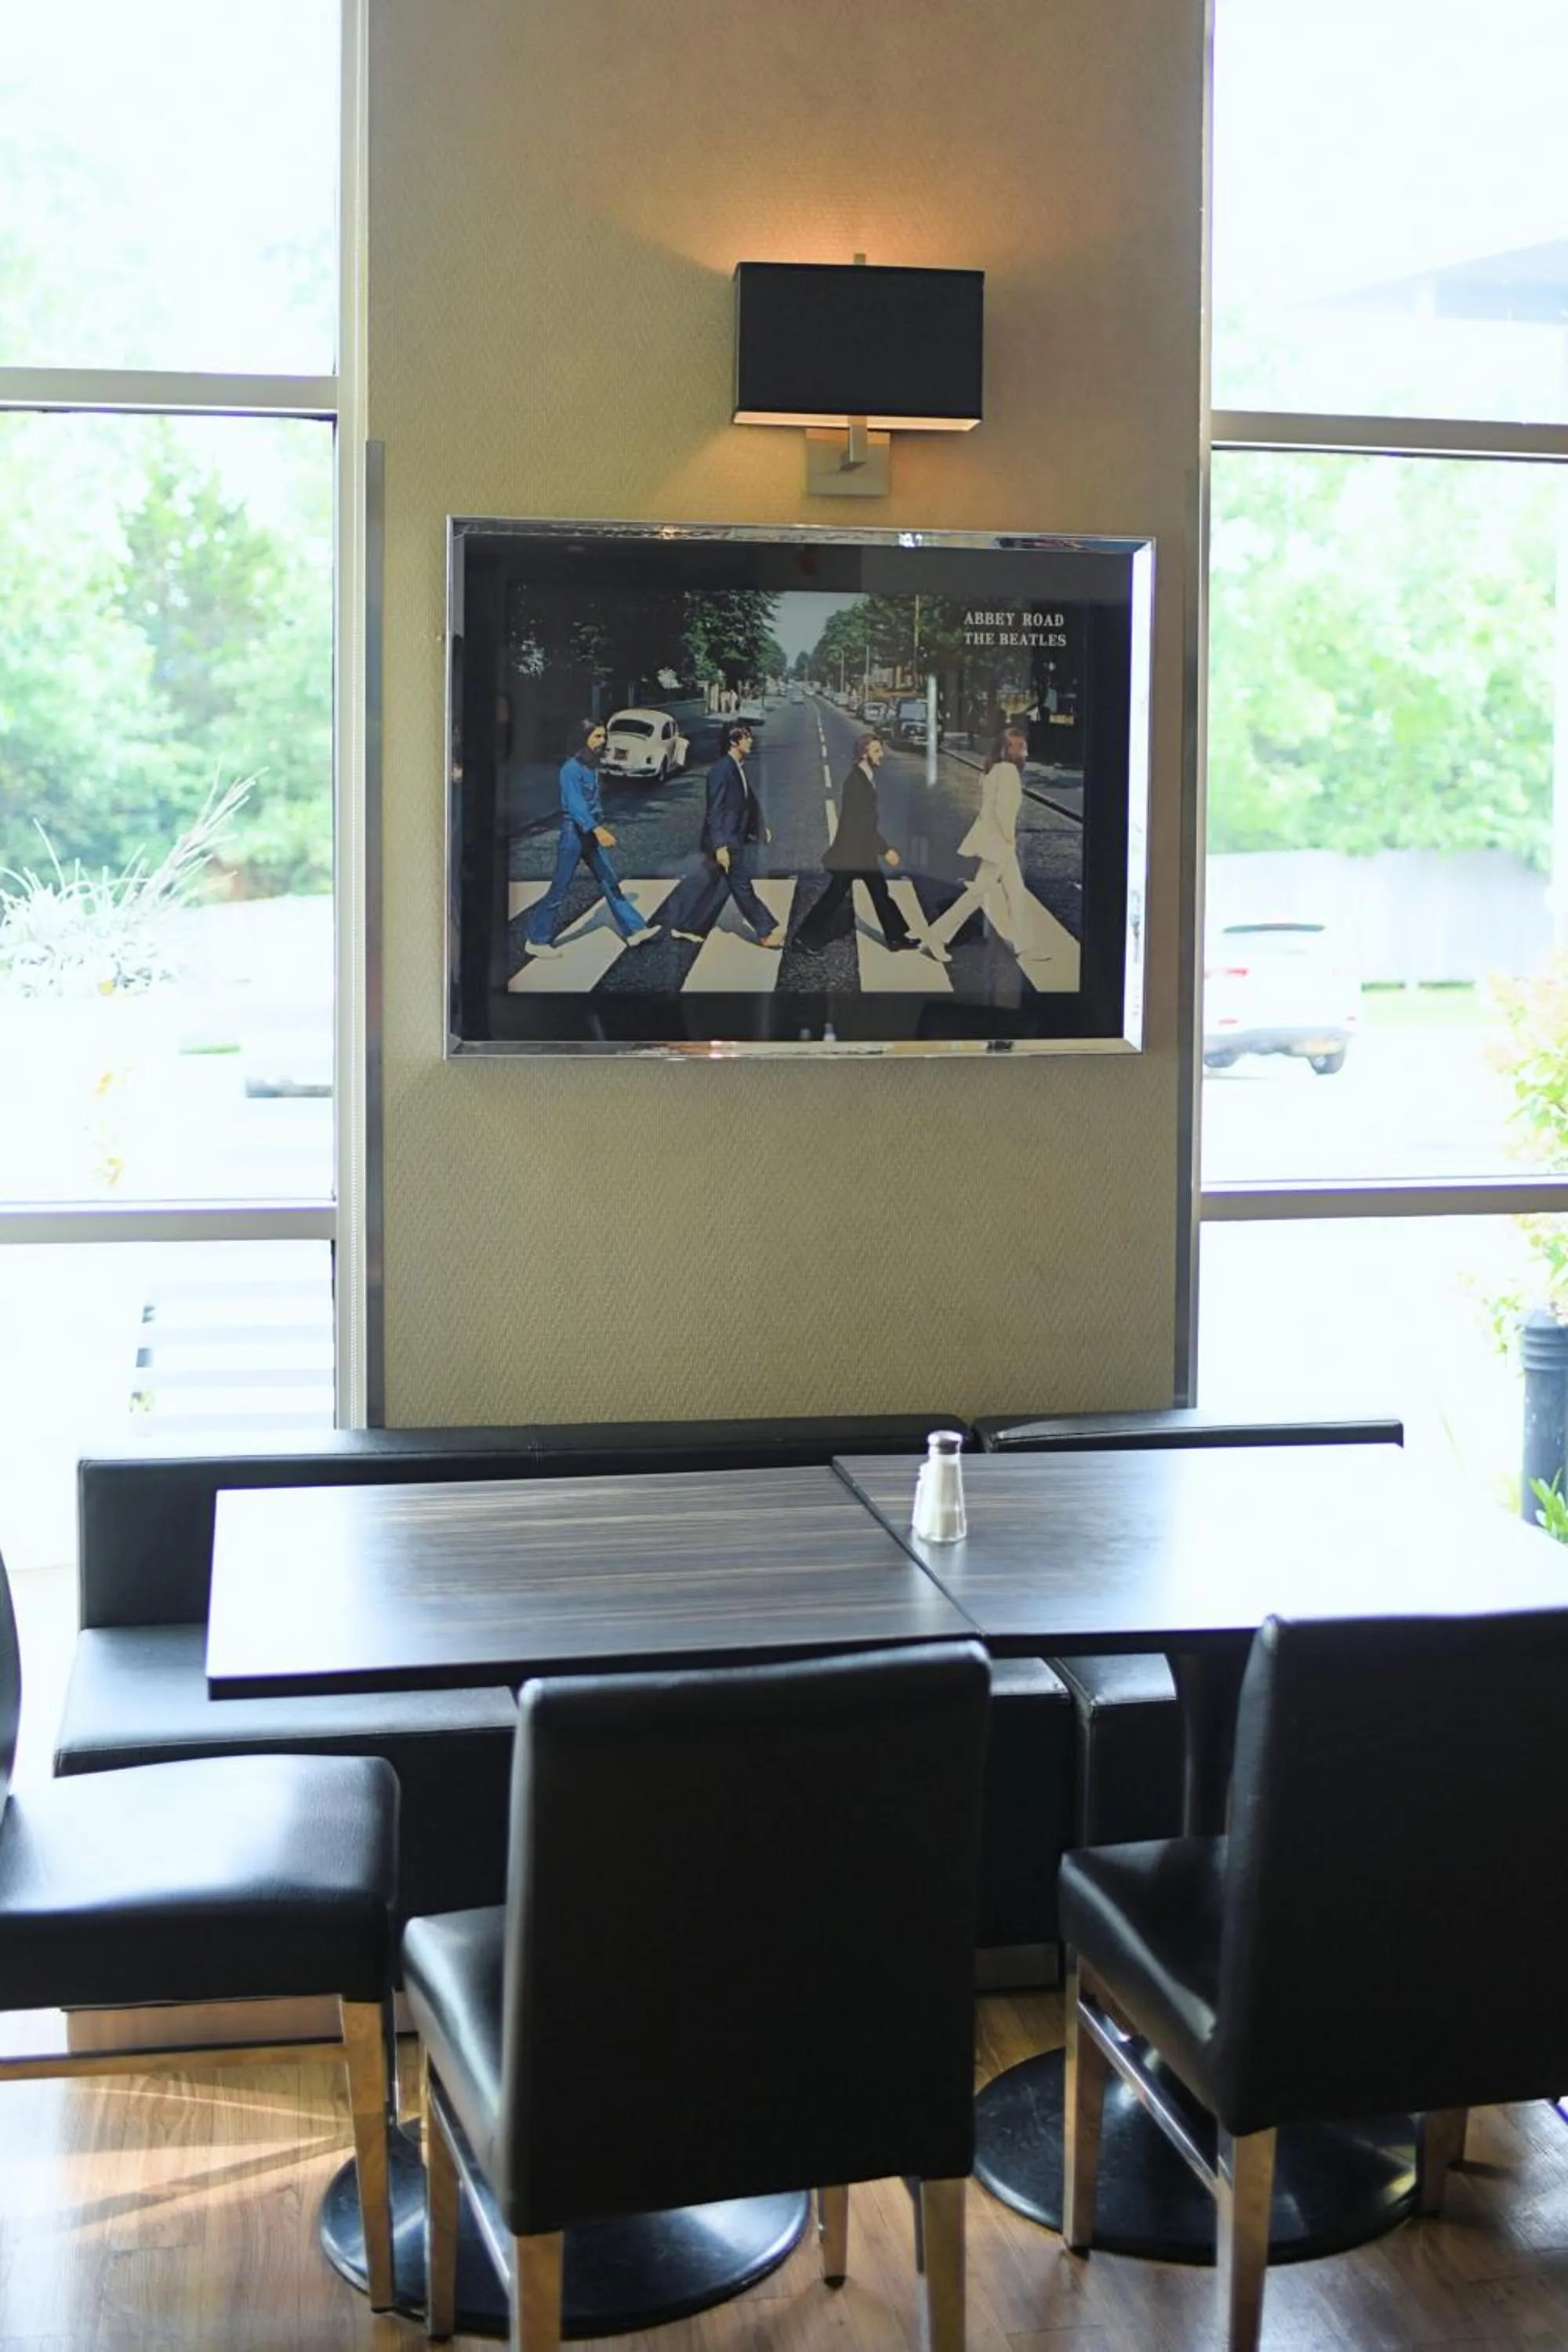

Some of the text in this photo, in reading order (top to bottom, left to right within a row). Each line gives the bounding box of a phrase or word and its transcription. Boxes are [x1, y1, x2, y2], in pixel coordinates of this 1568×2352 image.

[964, 612, 1064, 626] ABBEY ROAD
[964, 632, 1067, 647] THE BEATLES
